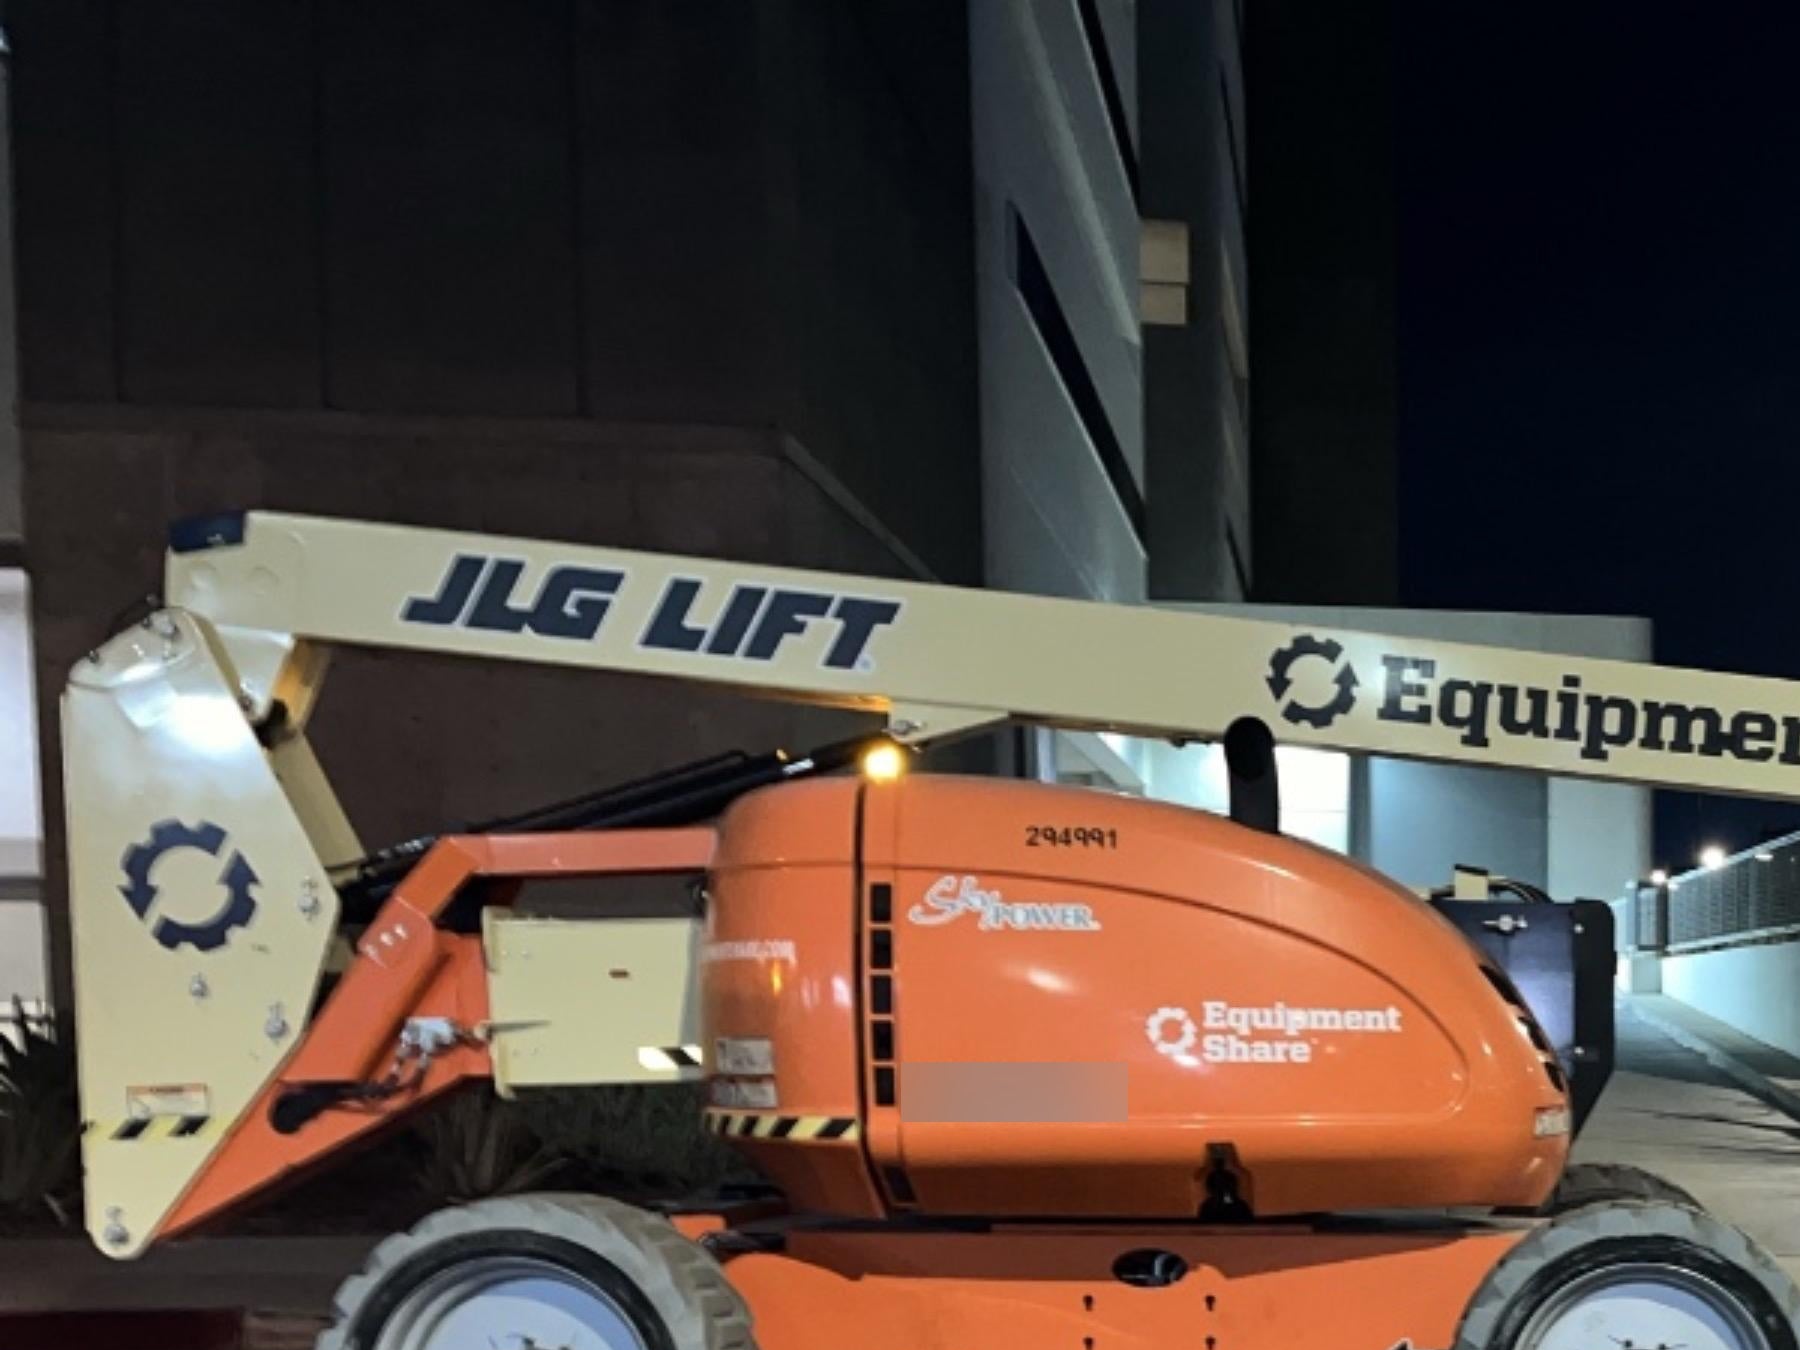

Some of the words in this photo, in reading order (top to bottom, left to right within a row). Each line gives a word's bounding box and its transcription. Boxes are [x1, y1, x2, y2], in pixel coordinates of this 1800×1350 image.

[399, 553, 626, 641] JLG
[637, 576, 903, 669] LIFT
[1025, 825, 1118, 849] 294991
[1202, 1001, 1402, 1036] Equipment
[1202, 1034, 1312, 1063] Share
